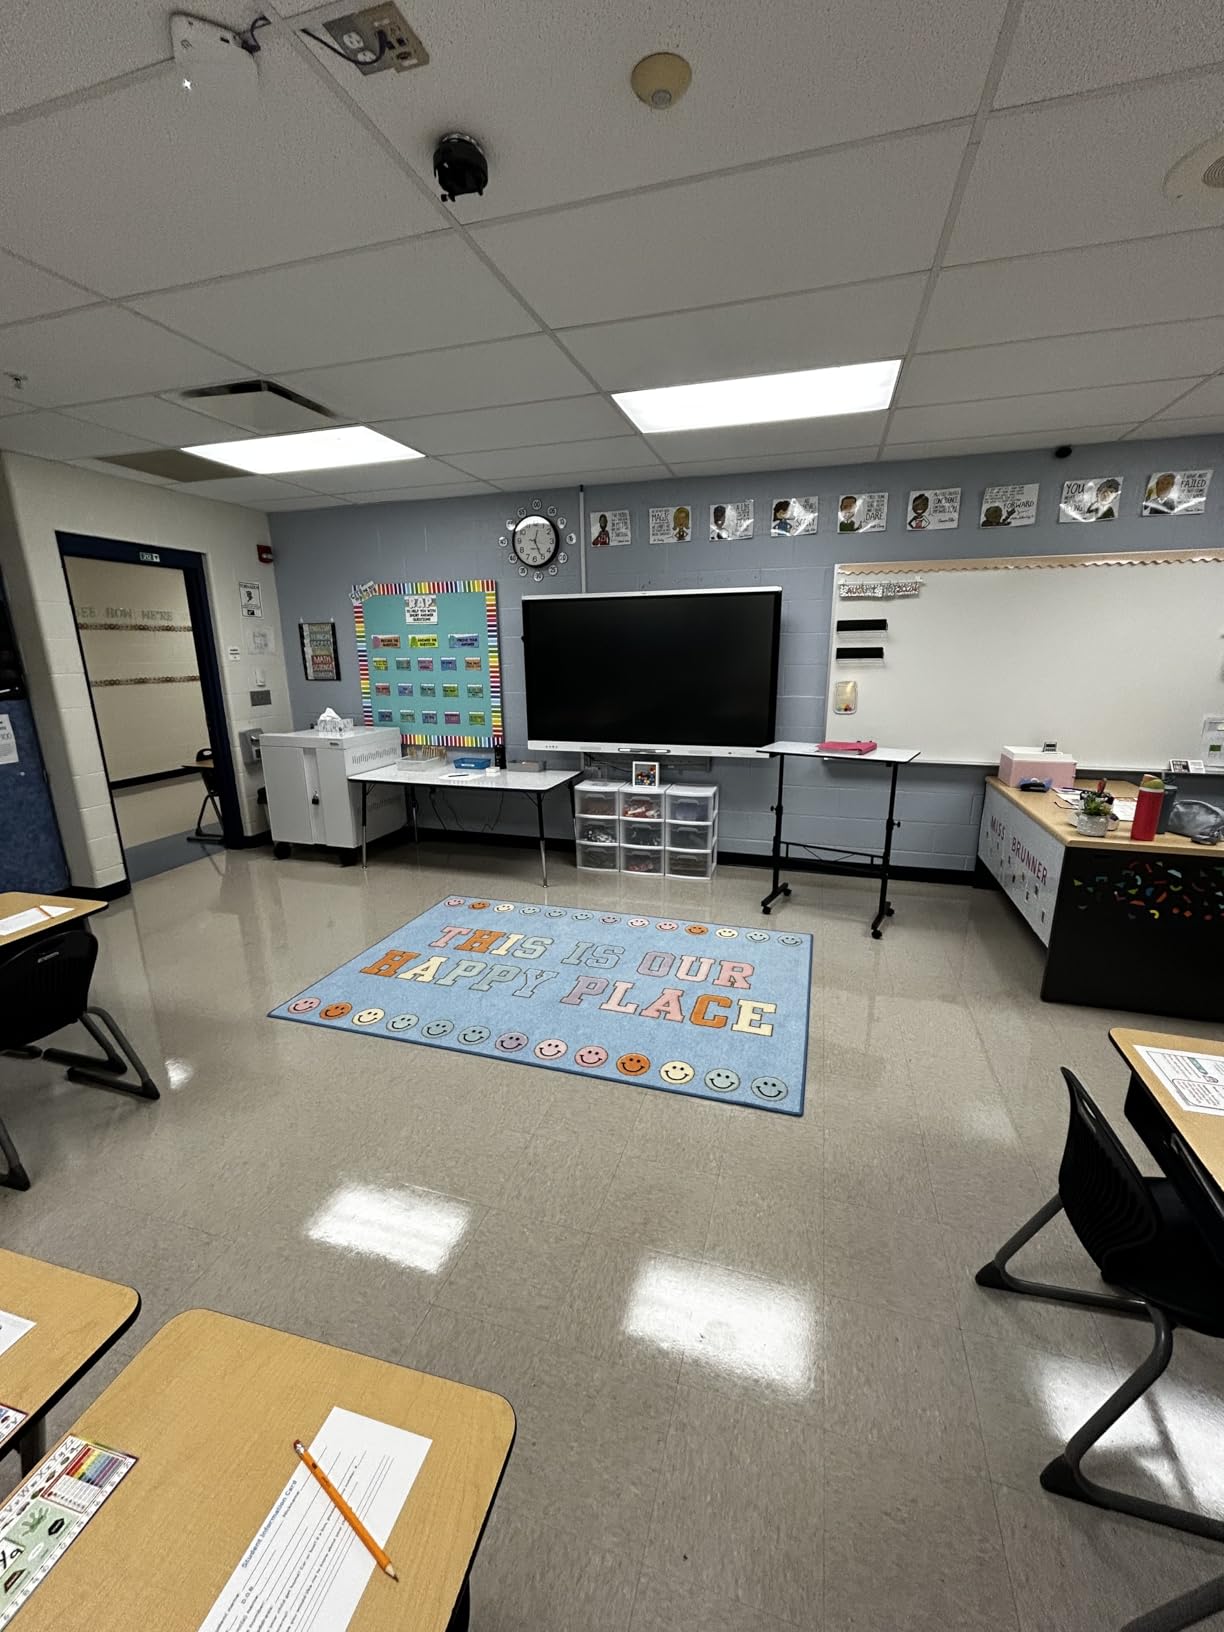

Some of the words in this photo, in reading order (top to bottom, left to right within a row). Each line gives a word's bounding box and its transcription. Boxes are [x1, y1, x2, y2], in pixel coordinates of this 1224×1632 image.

[1066, 482, 1085, 494] YOU
[1180, 479, 1207, 488] FAILED
[1004, 500, 1034, 510] FORWARD
[866, 512, 884, 520] DARE
[408, 597, 432, 608] RAP
[313, 656, 332, 664] MATH
[991, 816, 1005, 840] MISS
[1012, 836, 1048, 886] BRUNNER
[428, 925, 555, 960] THIS
[560, 942, 626, 970] IS
[636, 950, 754, 990] OUR
[360, 949, 560, 998] HAPPY
[560, 974, 777, 1038] PLACE
[241, 1538, 261, 1568] Student
[260, 1497, 286, 1537] Information
[285, 1480, 297, 1496] Card
